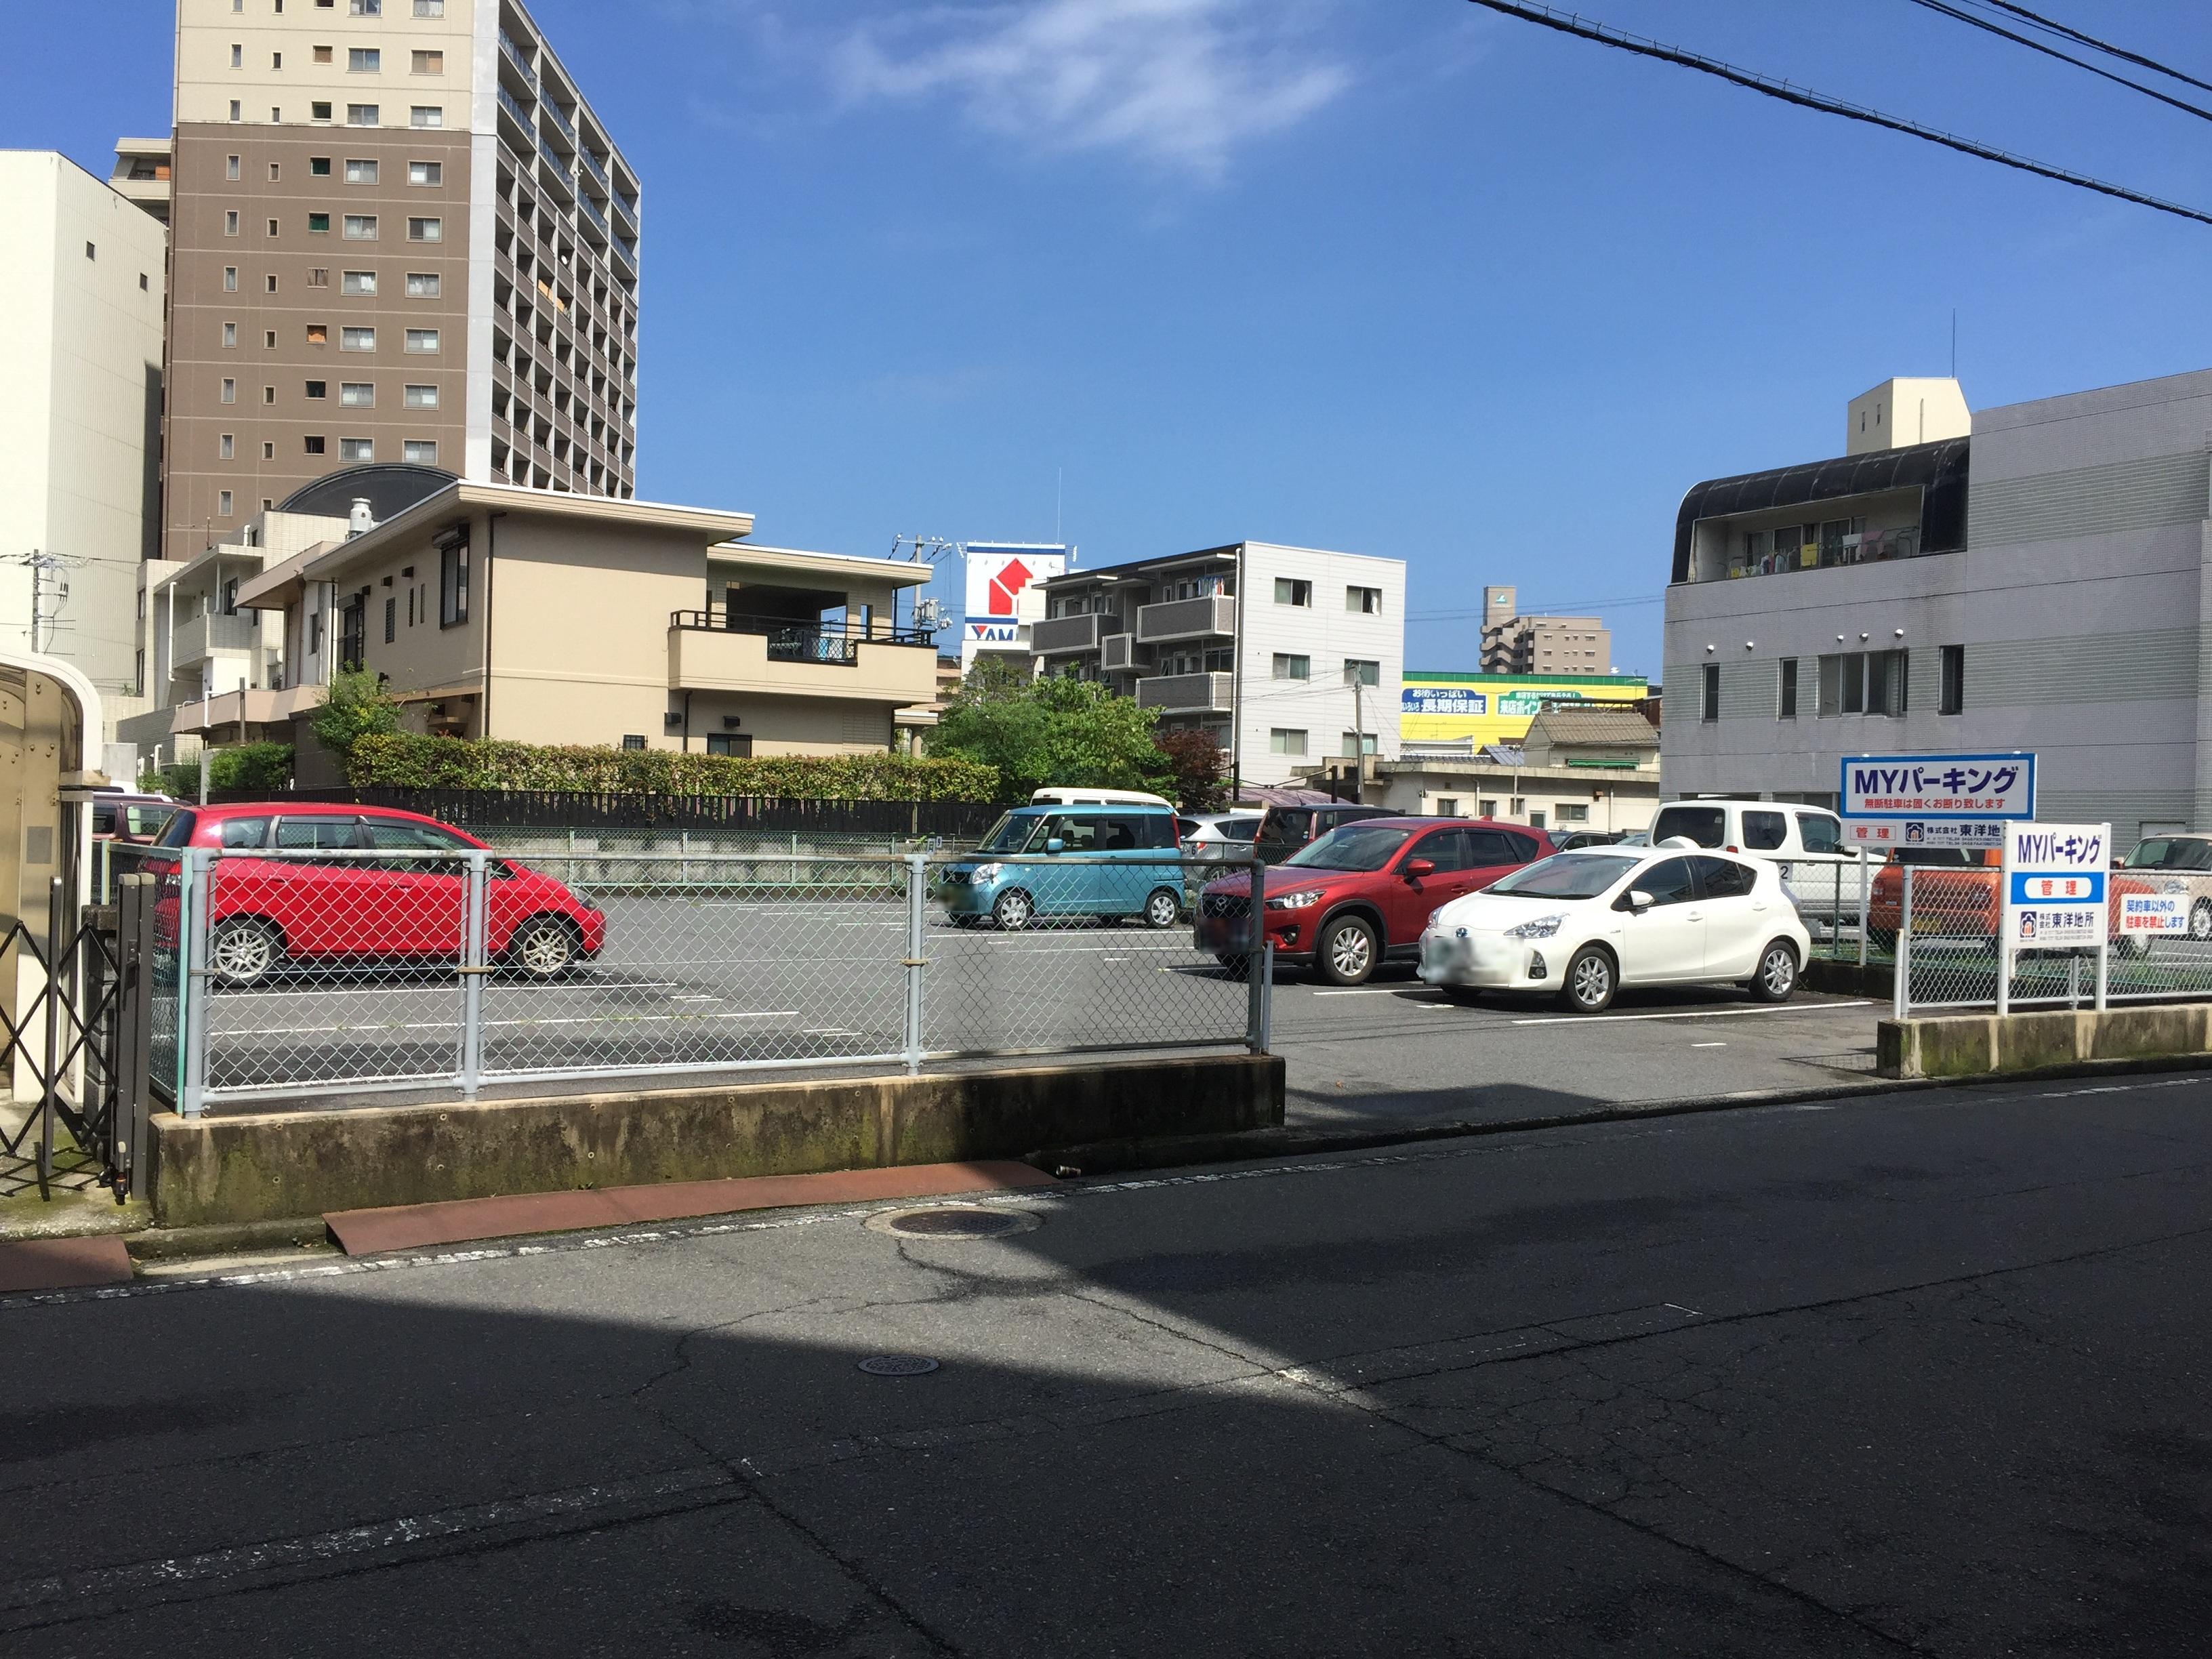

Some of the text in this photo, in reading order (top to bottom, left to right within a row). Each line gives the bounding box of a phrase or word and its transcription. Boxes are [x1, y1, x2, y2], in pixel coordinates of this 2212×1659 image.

[1421, 699, 1484, 714] 長期保証
[1855, 766, 2019, 794] MYパーキング
[1864, 798, 2005, 809] 無断駐車は固くお断り致します
[1856, 827, 1889, 839] 管理
[1927, 826, 1958, 834] 株式会社
[1191, 845, 1196, 855] 6
[2018, 832, 2102, 864] MYパーキング
[1780, 865, 1788, 879] 2
[2041, 880, 2076, 896] 管理
[2127, 900, 2175, 912] 契約車以外の
[2052, 912, 2094, 928] 東洋地所
[2126, 916, 2184, 928] 駐車を禁止します
